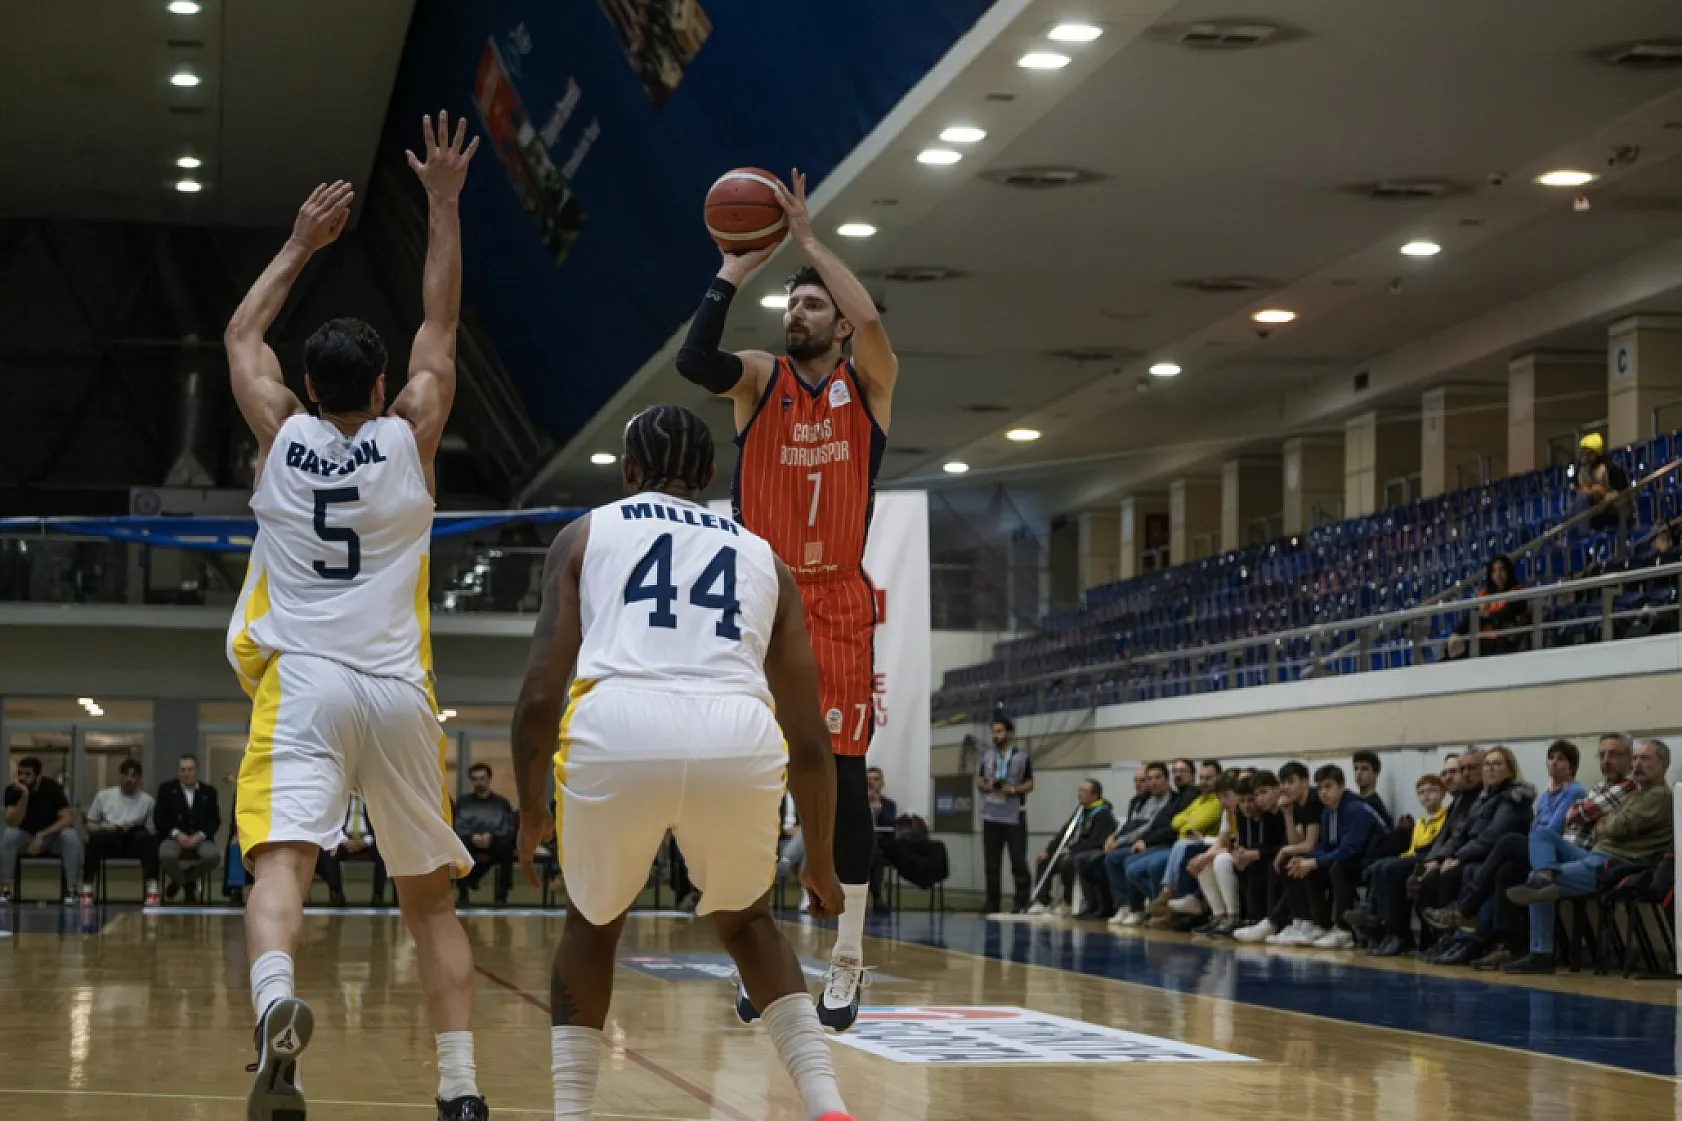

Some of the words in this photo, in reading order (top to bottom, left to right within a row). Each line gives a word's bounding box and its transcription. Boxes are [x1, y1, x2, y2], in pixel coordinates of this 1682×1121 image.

[620, 503, 740, 536] MILLER
[807, 472, 822, 527] 7
[312, 487, 361, 580] 5
[624, 533, 742, 641] 44
[854, 703, 867, 741] 7
